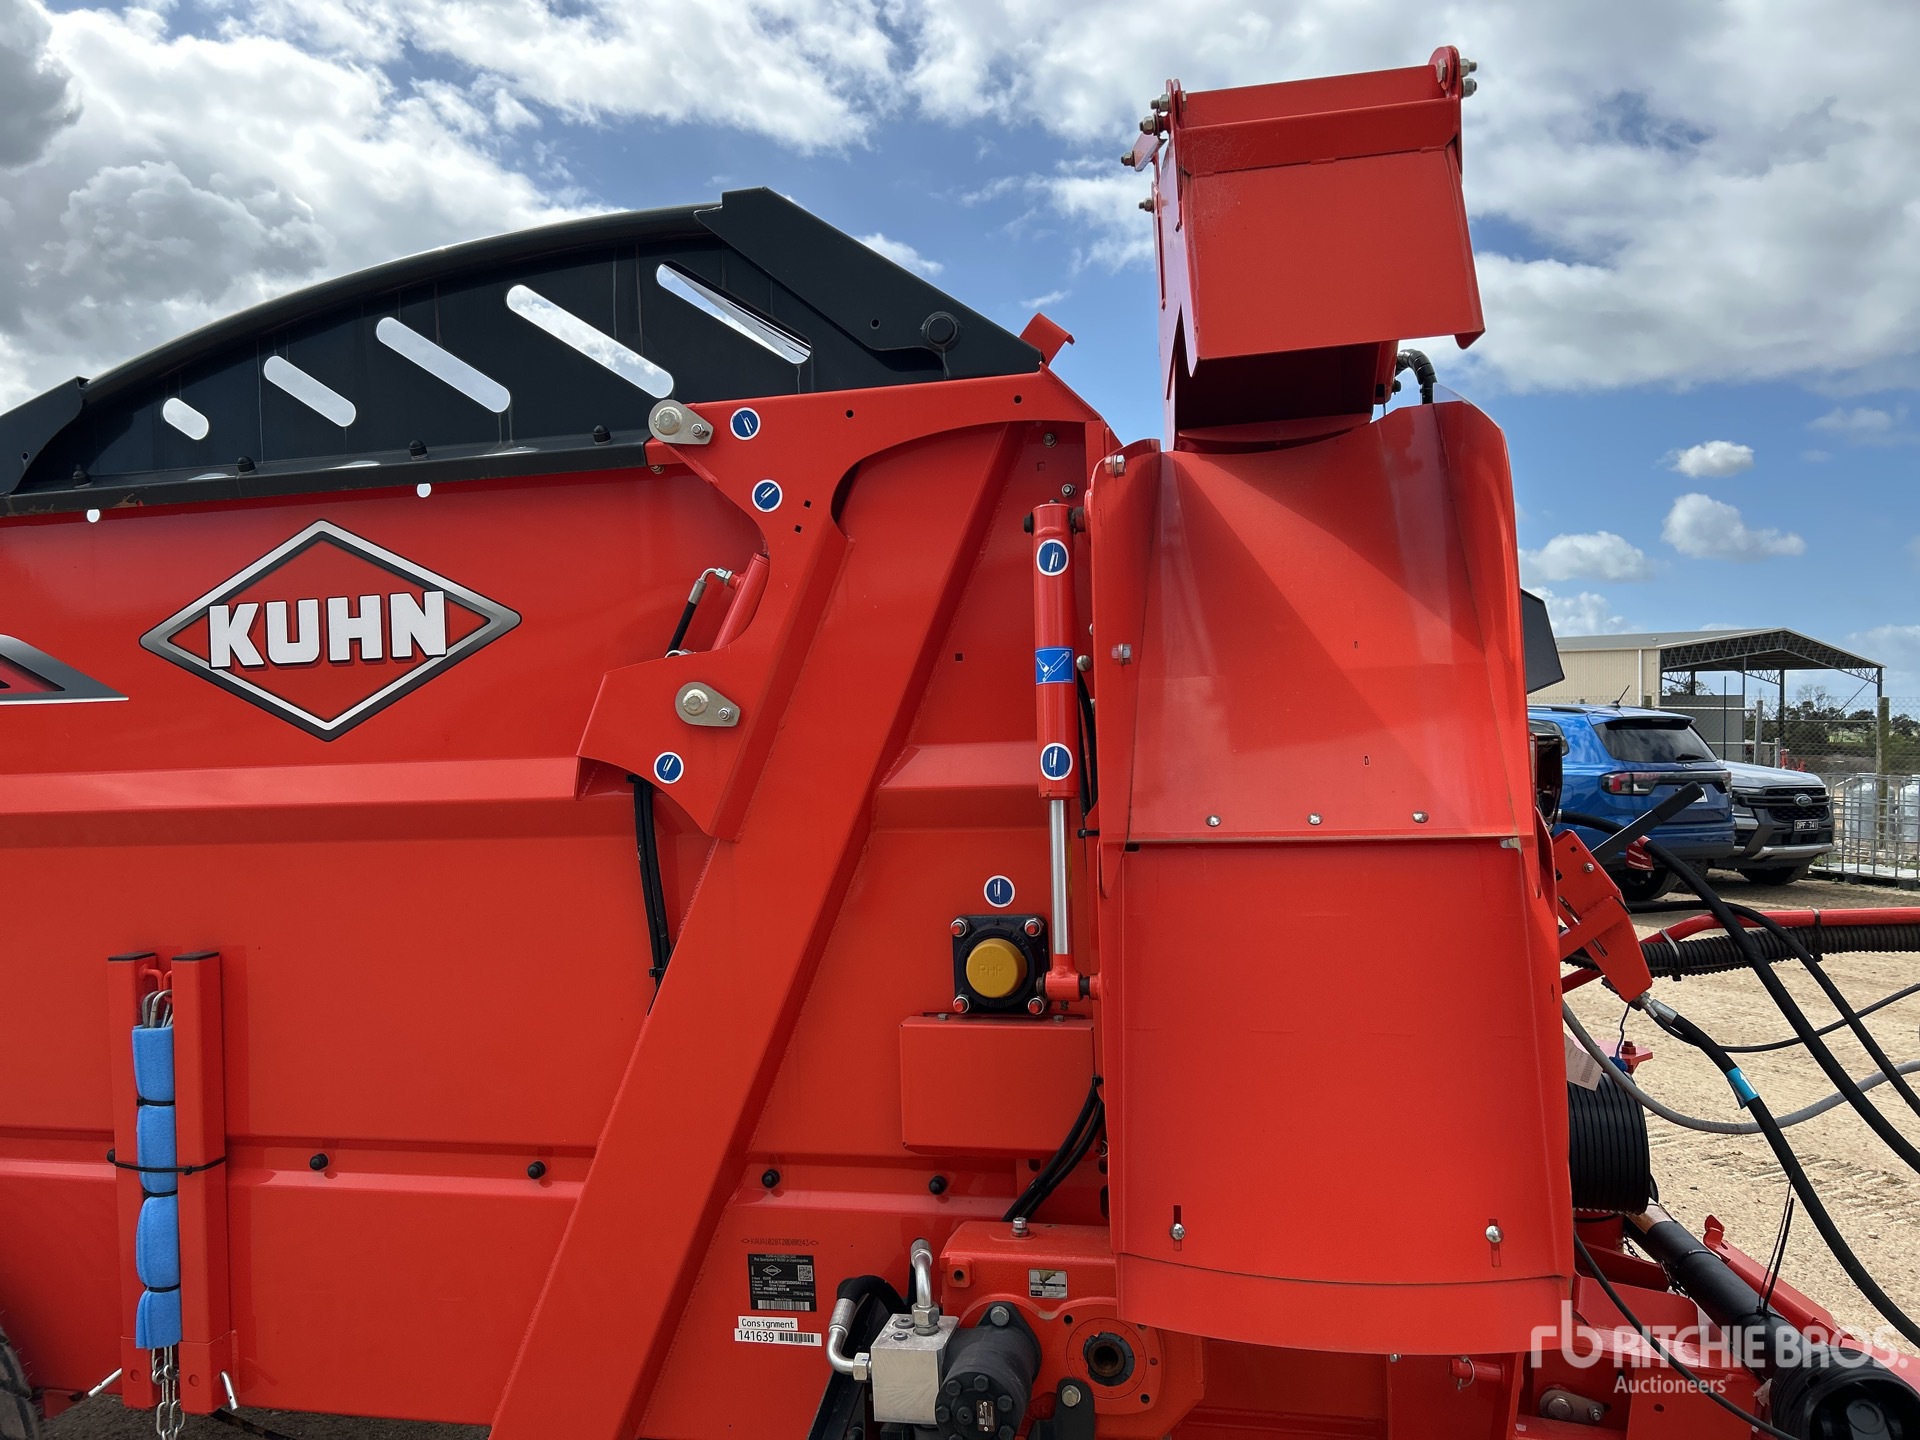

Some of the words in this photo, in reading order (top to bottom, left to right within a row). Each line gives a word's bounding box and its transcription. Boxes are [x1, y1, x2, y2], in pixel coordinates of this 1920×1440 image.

[209, 590, 447, 669] KUHN
[741, 1318, 795, 1330] Consignment
[738, 1330, 775, 1343] 141639
